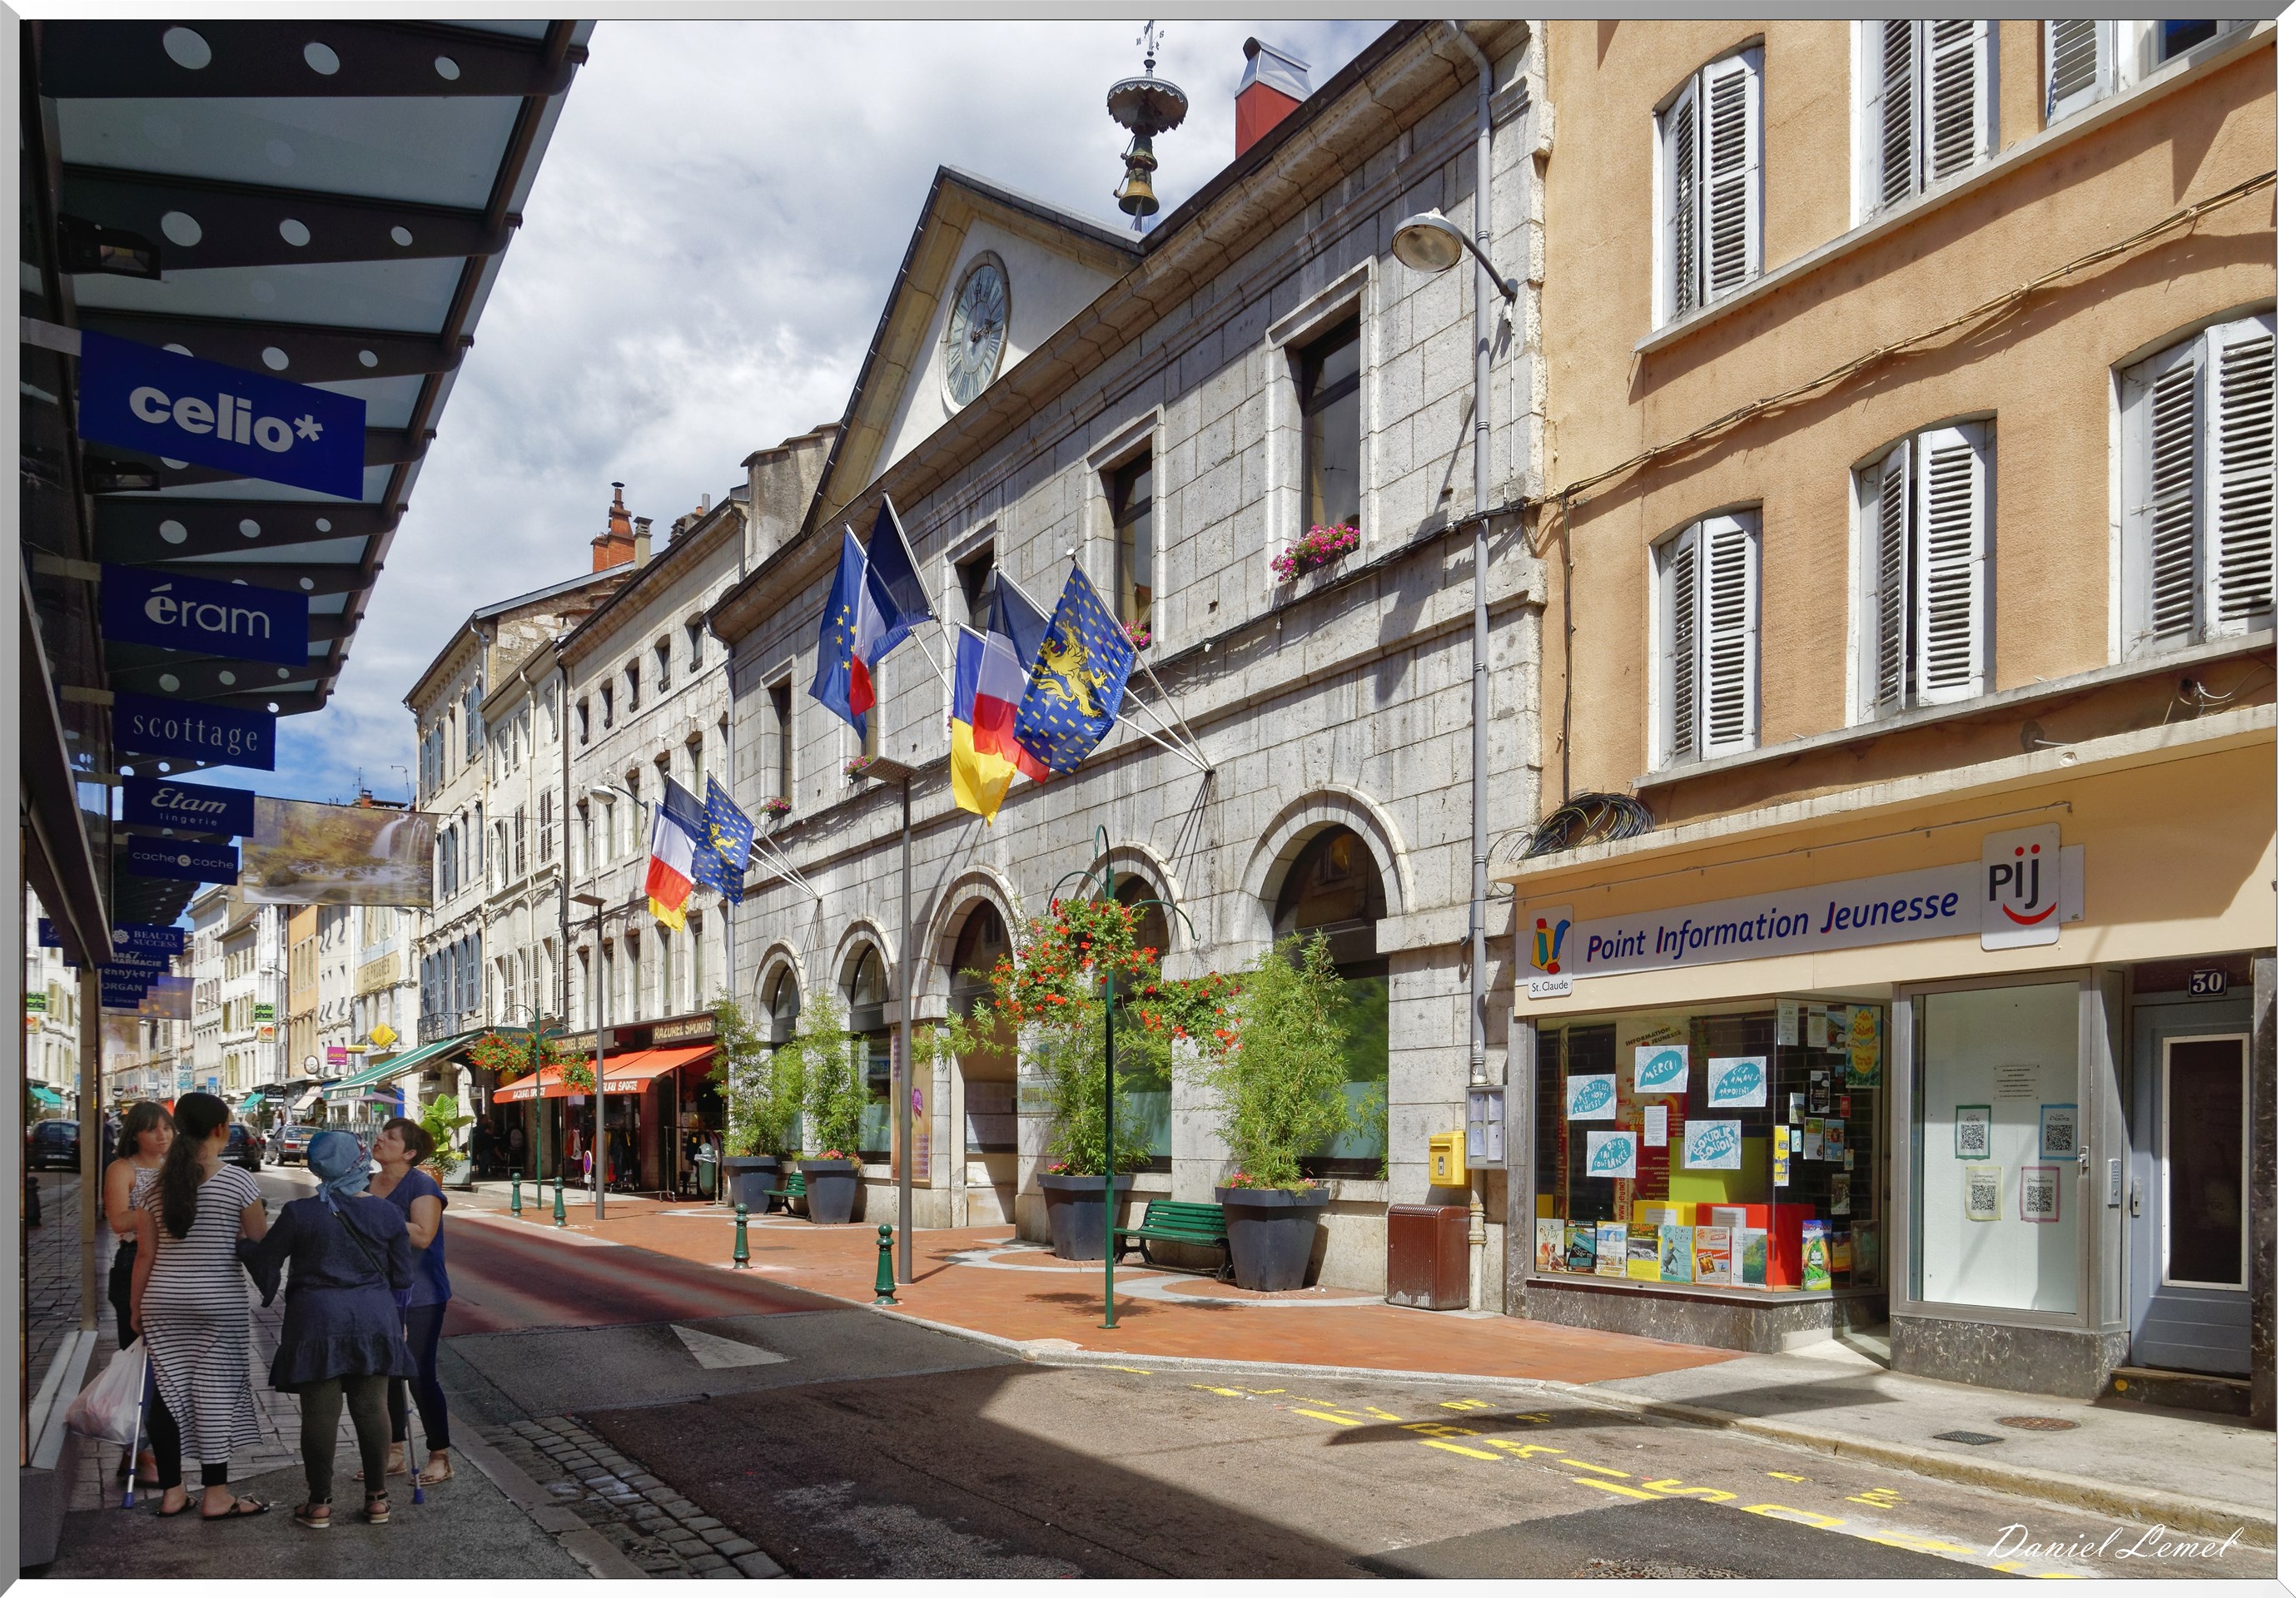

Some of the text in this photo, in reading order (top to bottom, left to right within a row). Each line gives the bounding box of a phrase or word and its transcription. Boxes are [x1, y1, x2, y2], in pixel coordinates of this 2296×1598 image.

[144, 583, 271, 638] éram
[133, 714, 257, 756] scottage
[151, 787, 227, 814] Etam
[160, 813, 218, 826] lingerie
[132, 851, 176, 863] cache
[192, 857, 234, 870] cache
[1587, 891, 1959, 963] Point Information Jeunesse
[133, 939, 178, 948] SUCCESS
[134, 931, 177, 941] BEAUTY
[103, 968, 154, 979] ennyfer
[102, 983, 142, 992] ORGAN
[1532, 980, 1568, 992] St. Claude
[2193, 972, 2223, 993] 30
[654, 1017, 712, 1040] RAZUREL SPORTS
[1625, 1026, 1671, 1046] INFORMATION
[1651, 1030, 1682, 1045] JEUNESSE
[530, 1087, 546, 1097] SPOTS
